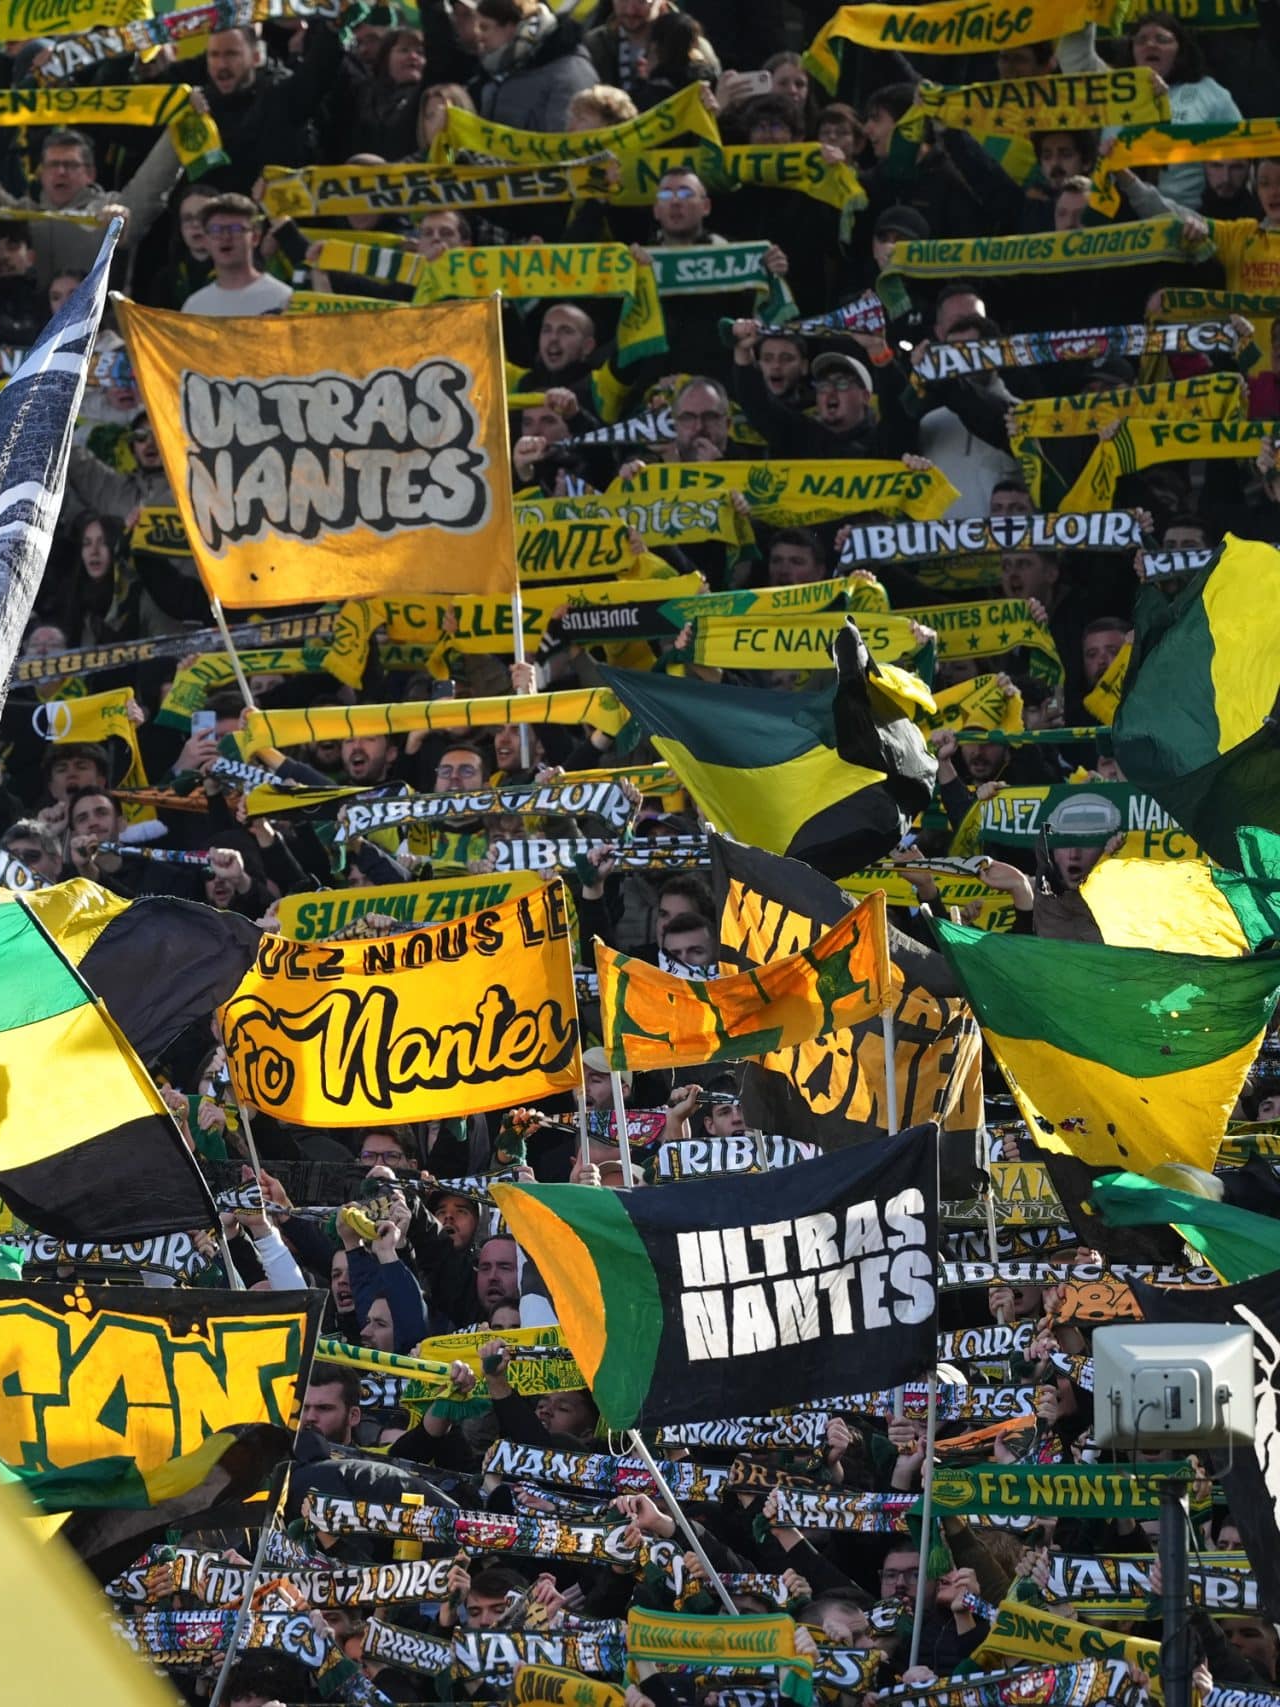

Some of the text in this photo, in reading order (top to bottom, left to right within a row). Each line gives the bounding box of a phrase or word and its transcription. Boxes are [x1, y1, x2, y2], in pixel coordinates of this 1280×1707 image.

[881, 4, 1033, 45] Nantaise
[964, 74, 1137, 109] NANTES
[370, 170, 569, 208] NANTES
[449, 253, 488, 278] FC
[500, 247, 632, 279] NANTES
[906, 224, 1153, 265] Allez Nantes Canaris
[185, 361, 472, 450] ULTRAS
[1151, 422, 1201, 447] FC
[188, 446, 488, 551] NANTES
[797, 472, 933, 498] NANTES
[562, 607, 640, 630] JUVENTUS
[734, 627, 890, 652] FC NANES
[1143, 830, 1187, 859] FC
[363, 907, 504, 975] NOUS
[277, 983, 579, 1109] Nantes
[677, 1187, 927, 1288] ULTRAS
[680, 1249, 936, 1361] NANTES
[972, 1387, 1035, 1419] TES
[486, 1440, 578, 1481] NAN
[980, 1473, 1161, 1507] FC NANTES
[357, 1560, 454, 1601] LOIRE
[992, 1610, 1073, 1653] SINCE
